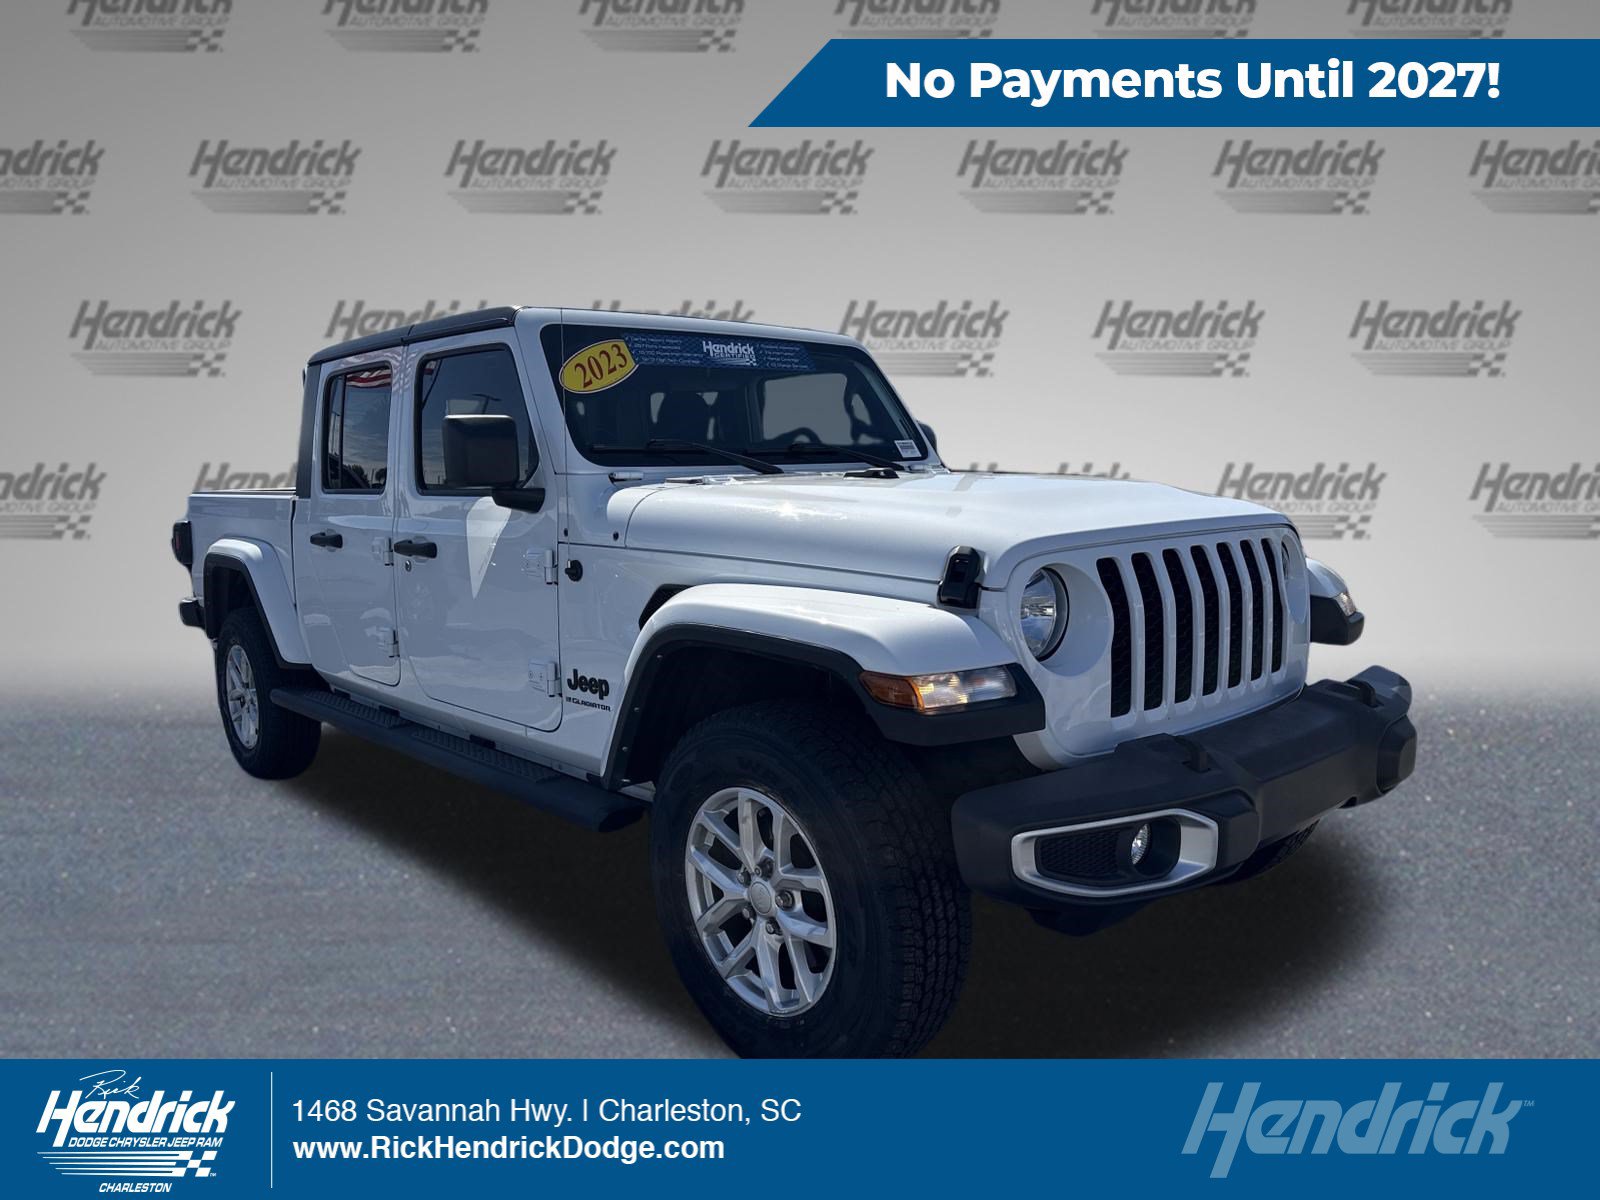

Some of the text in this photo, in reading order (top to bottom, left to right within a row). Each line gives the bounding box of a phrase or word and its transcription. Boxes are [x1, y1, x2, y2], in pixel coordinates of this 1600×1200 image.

[189, 140, 361, 188] Hendrick
[445, 140, 617, 188] Hendrick
[701, 140, 873, 188] Hendrick
[957, 140, 1129, 188] Hendrick
[1213, 140, 1385, 188] Hendrick
[69, 301, 241, 349] Hendrick
[838, 301, 1009, 341] Hendrick
[1093, 301, 1265, 349] Hendrick
[1349, 301, 1521, 349] Hendrick
[574, 343, 628, 388] 2023
[702, 341, 754, 357] Hendrick
[1214, 462, 1387, 500] Hendrick
[567, 668, 610, 700] Jeep
[572, 697, 611, 712] GLADIATOR
